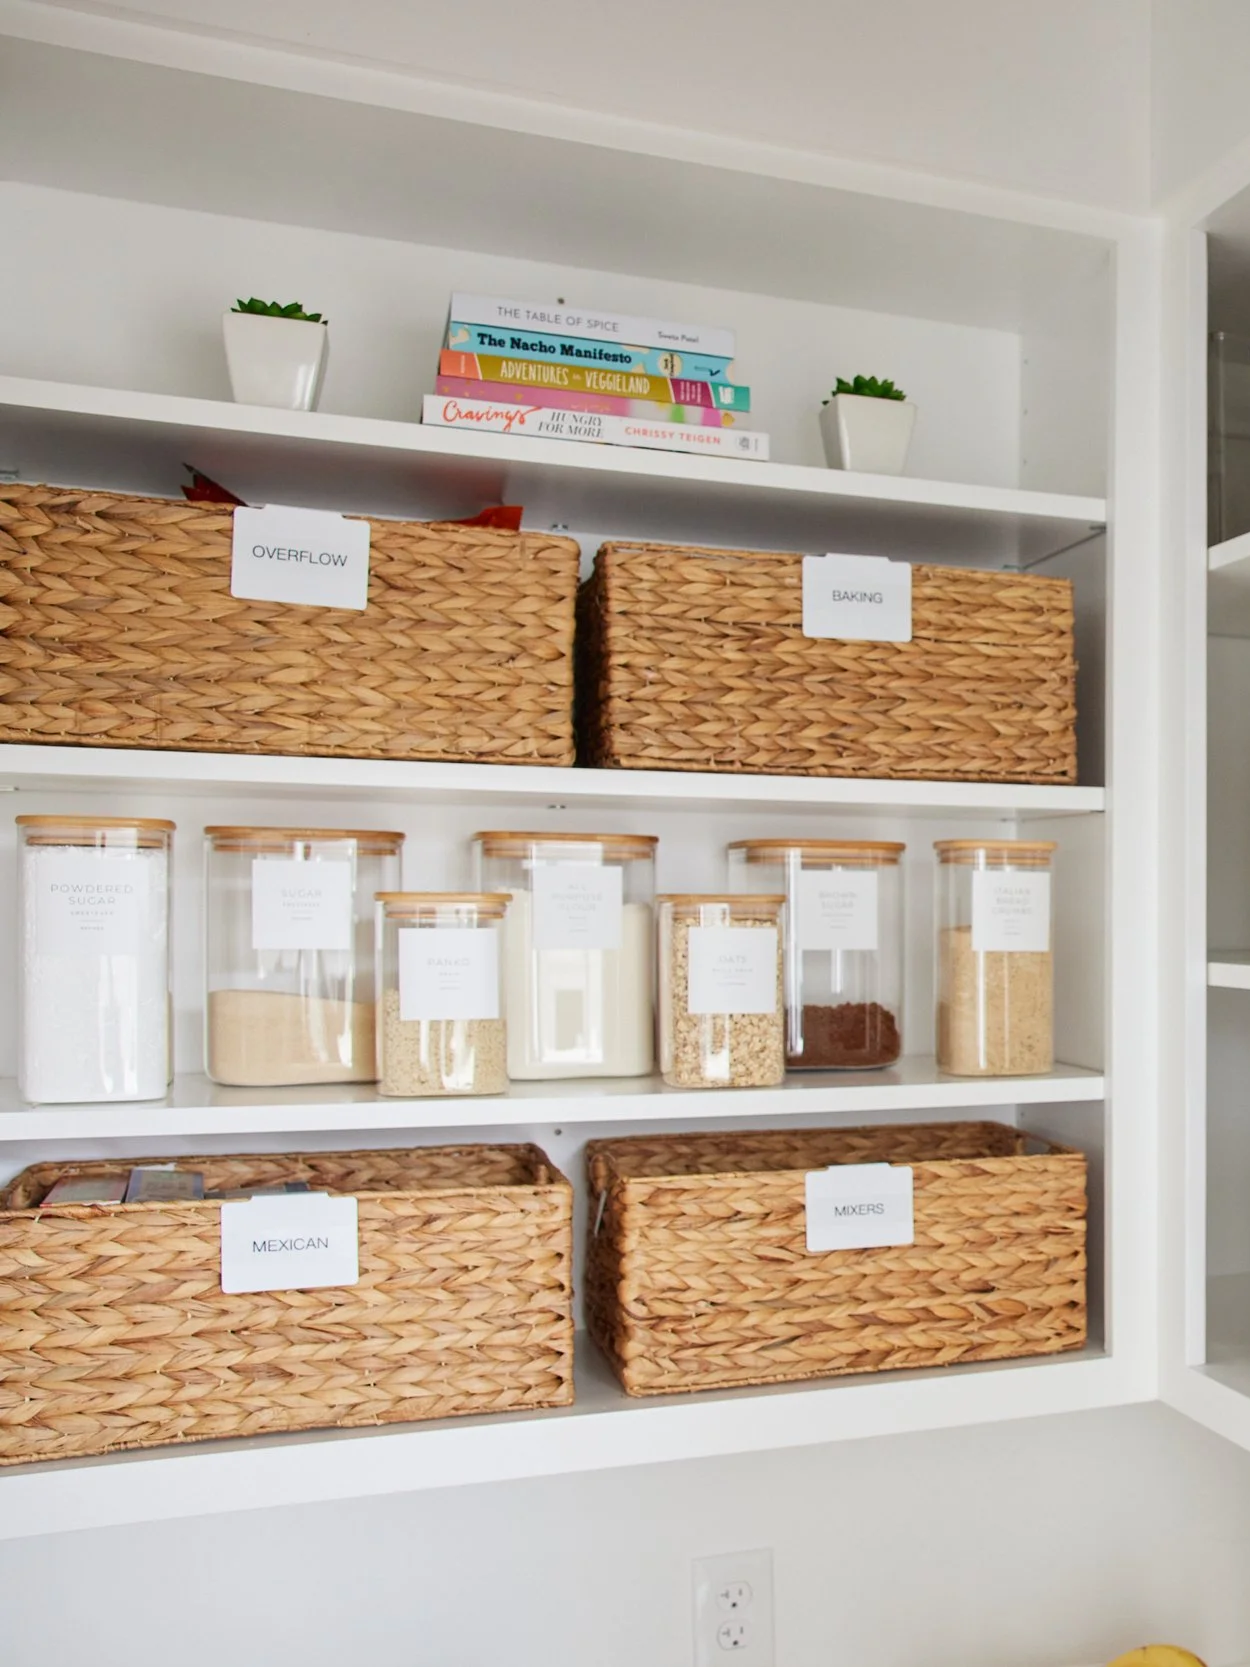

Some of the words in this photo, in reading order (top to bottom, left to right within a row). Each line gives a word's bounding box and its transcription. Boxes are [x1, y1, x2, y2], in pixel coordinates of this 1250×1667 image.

[497, 305, 521, 319] THE
[525, 310, 562, 325] TABLE
[565, 315, 583, 327] OF
[586, 317, 620, 333] SPICE
[476, 332, 506, 349] The
[509, 336, 556, 355] Nacho
[559, 343, 632, 365] Manifesto
[500, 360, 569, 386] ADVENTURES
[584, 370, 650, 395] VEGGIELAND
[442, 400, 543, 433] Cravings
[550, 411, 604, 427] HUNGRY
[624, 426, 676, 440] CHRISSY
[679, 432, 721, 446] TEIGEN
[538, 420, 564, 435] FOR
[567, 423, 605, 438] MORE
[252, 544, 348, 568] OVERFLOW
[832, 589, 883, 604] BAKING
[49, 883, 133, 894] POWDERED
[280, 888, 322, 899] SUGAR
[67, 896, 115, 906] SUGAR
[834, 1203, 885, 1218] MIXERS
[252, 1236, 329, 1254] MEXICAN
